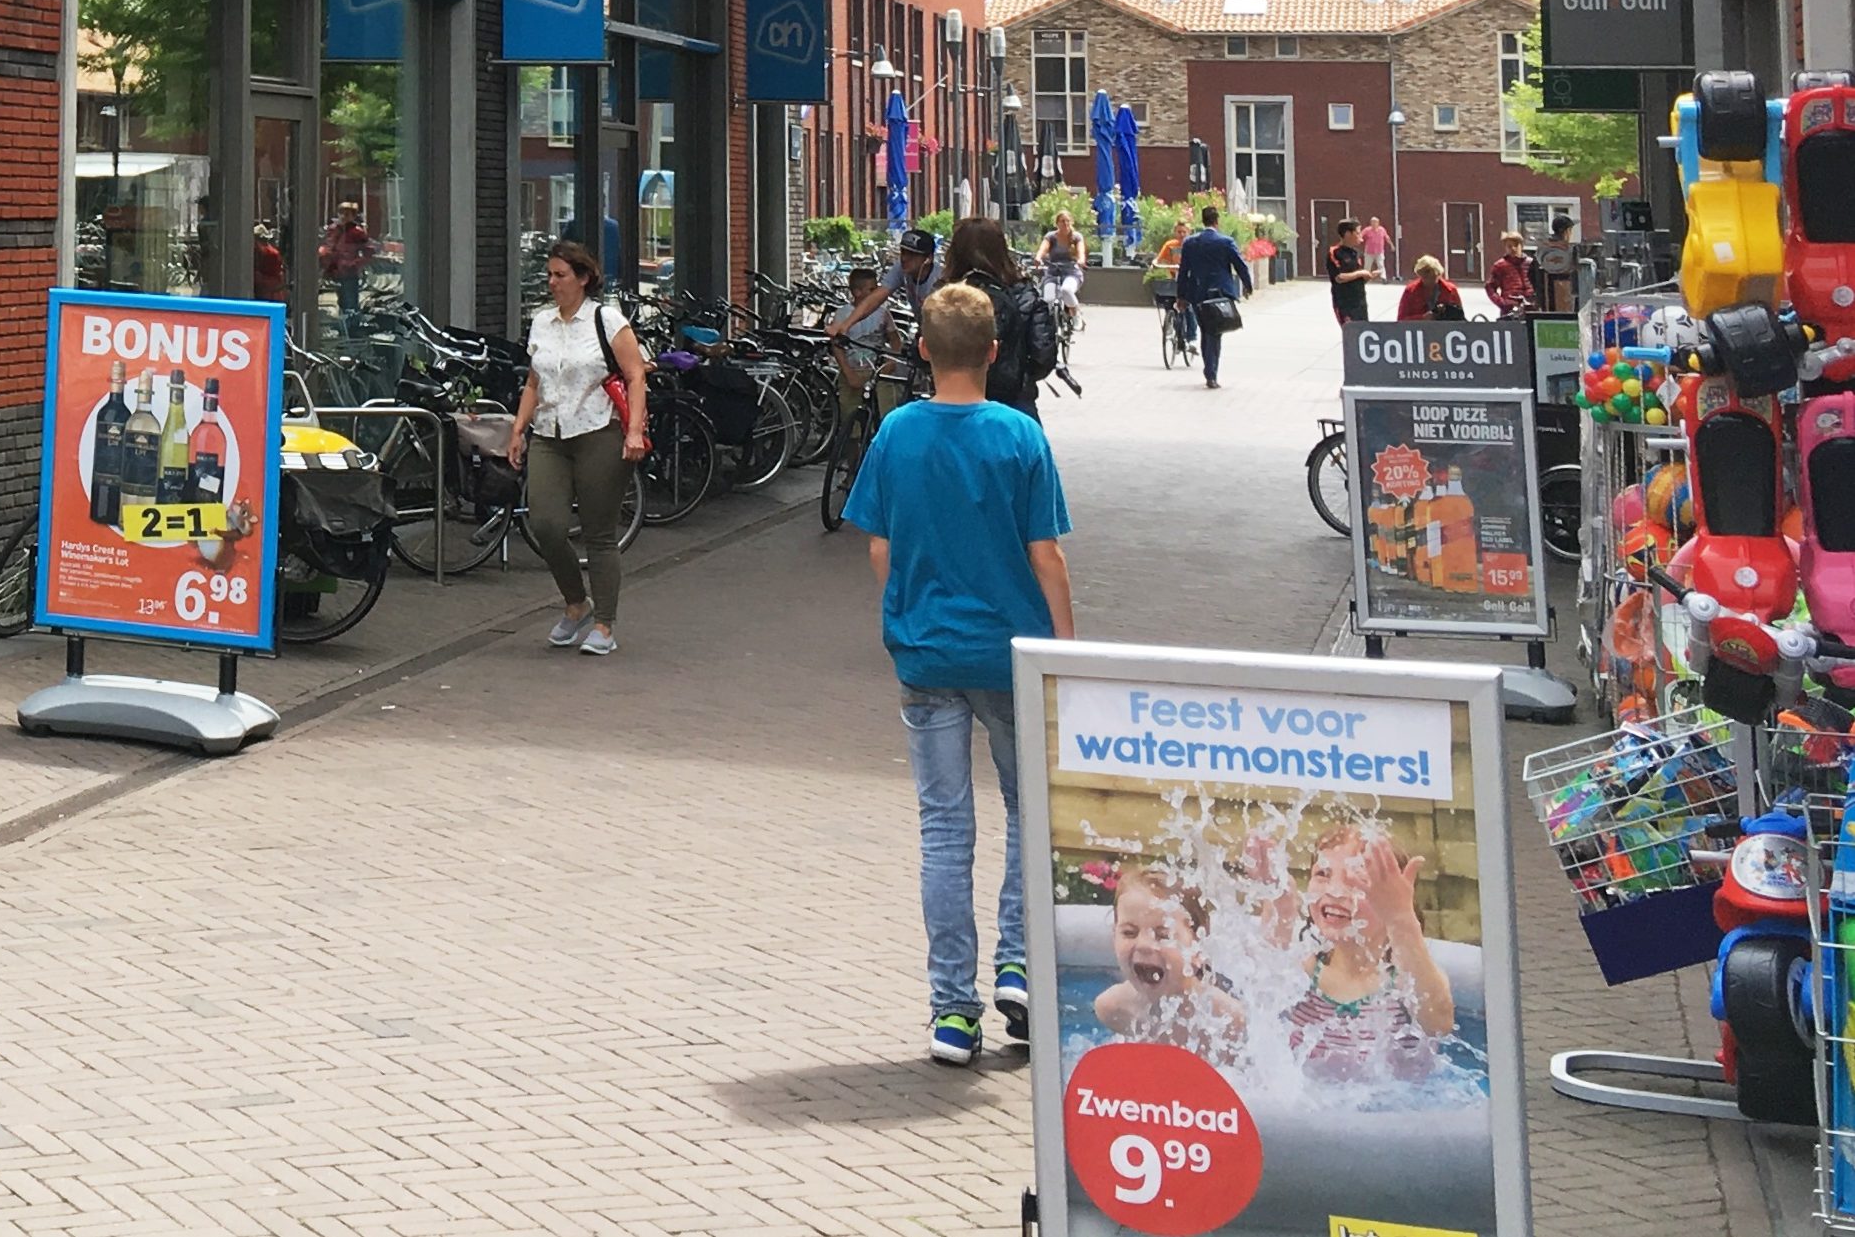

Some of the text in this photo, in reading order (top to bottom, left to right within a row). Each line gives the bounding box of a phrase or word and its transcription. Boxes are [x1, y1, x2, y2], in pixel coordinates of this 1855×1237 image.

[82, 315, 251, 371] BONUS
[1358, 330, 1425, 364] Gall
[1446, 330, 1514, 364] Gall
[1399, 370, 1439, 379] SINDS
[1412, 405, 1489, 422] LOOP DEZE
[1413, 423, 1514, 440] NIET VOORBIJ
[1383, 465, 1419, 481] 20%
[141, 507, 208, 538] 2=1
[61, 540, 128, 556] Hardys Crest en
[61, 549, 114, 565] Winemaker's
[174, 570, 248, 625] 6.98
[1129, 690, 1366, 738] Feest voor
[1075, 732, 1432, 787] watermonsters!
[1076, 1087, 1239, 1135] Zwembad
[1108, 1133, 1212, 1209] 9.99
